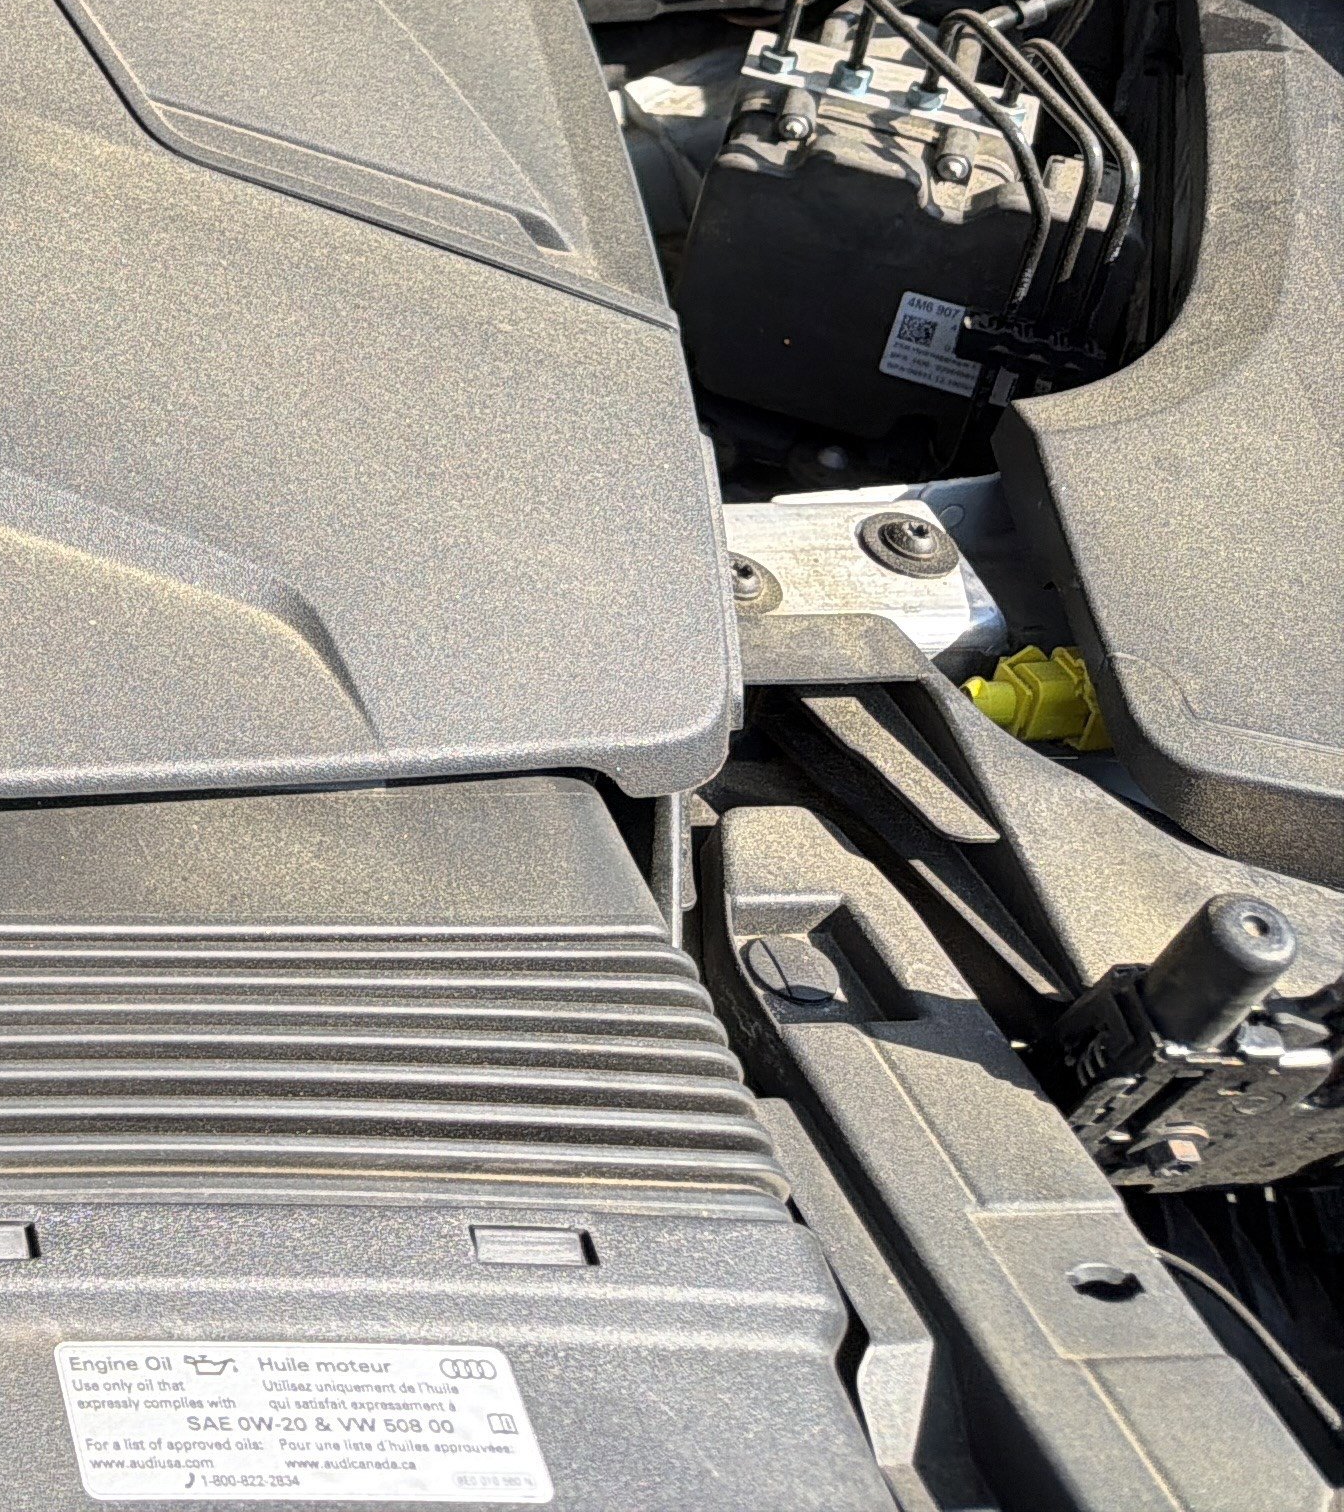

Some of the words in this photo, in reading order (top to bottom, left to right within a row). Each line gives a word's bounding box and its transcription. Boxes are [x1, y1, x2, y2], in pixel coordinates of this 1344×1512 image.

[68, 1356, 138, 1374] Engine
[145, 1355, 172, 1371] Oil
[257, 1357, 310, 1372] Huile
[315, 1359, 392, 1373] moteur
[71, 1379, 100, 1392] Use
[102, 1379, 133, 1394] only
[136, 1379, 154, 1392] oil
[157, 1379, 186, 1392] that
[261, 1379, 313, 1393] Utilisez
[314, 1380, 396, 1395] uniquement
[398, 1381, 416, 1394] de
[77, 1398, 140, 1411] expressly
[143, 1398, 205, 1411] complies
[207, 1397, 237, 1409] with
[268, 1399, 291, 1412] qui
[294, 1398, 348, 1411] satisfait
[186, 1416, 233, 1431] SAE
[237, 1416, 308, 1432] 0W-20
[314, 1416, 332, 1432] &
[337, 1417, 376, 1432] VW
[383, 1418, 423, 1434] 508
[428, 1419, 455, 1434] 00
[85, 1437, 109, 1451] For
[112, 1441, 121, 1451] a
[123, 1437, 145, 1451] list
[148, 1437, 163, 1451] of
[166, 1438, 231, 1453] approved
[278, 1438, 311, 1451] Pour
[315, 1442, 341, 1452] une
[344, 1438, 373, 1452] liste
[89, 1455, 214, 1470] www.audiusa.com
[284, 1457, 417, 1471] www.audicanada.ca
[200, 1474, 301, 1487] 1-800-822-2834
